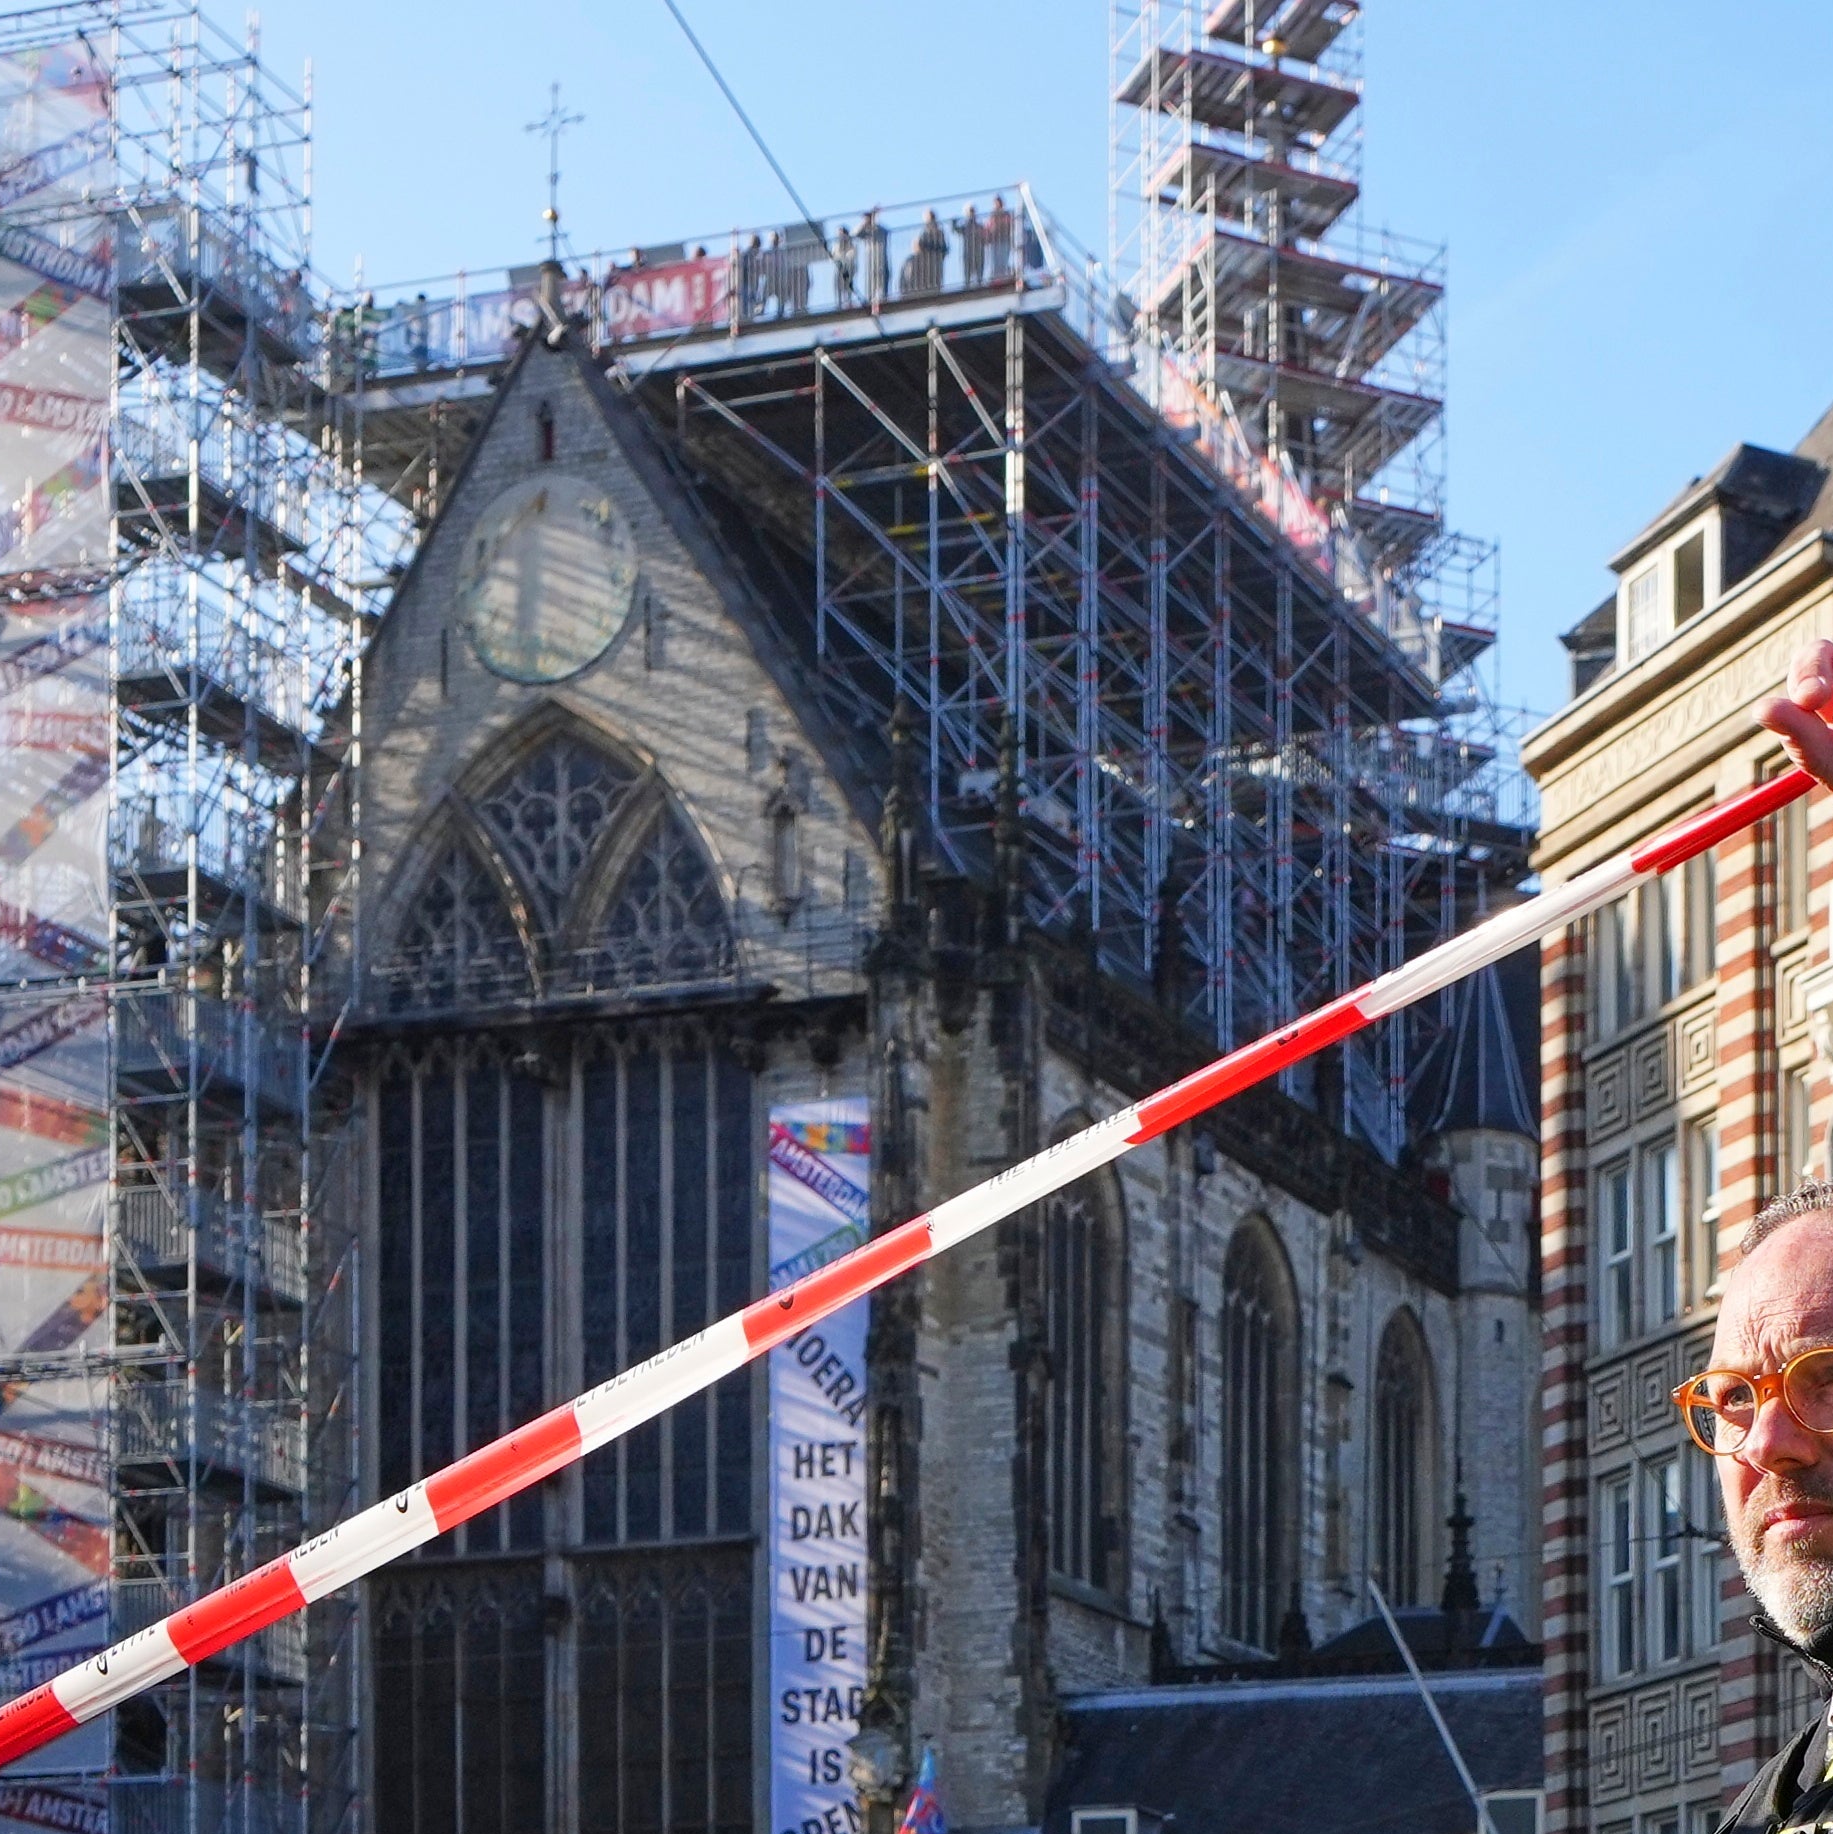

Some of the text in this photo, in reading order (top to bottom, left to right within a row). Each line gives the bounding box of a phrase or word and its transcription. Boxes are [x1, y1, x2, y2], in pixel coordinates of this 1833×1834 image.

[794, 1440, 858, 1479] HET
[792, 1501, 859, 1540] DAK
[790, 1563, 858, 1603] VAN
[804, 1627, 847, 1662] DE
[781, 1687, 864, 1723] STAD
[809, 1749, 841, 1785] IS
